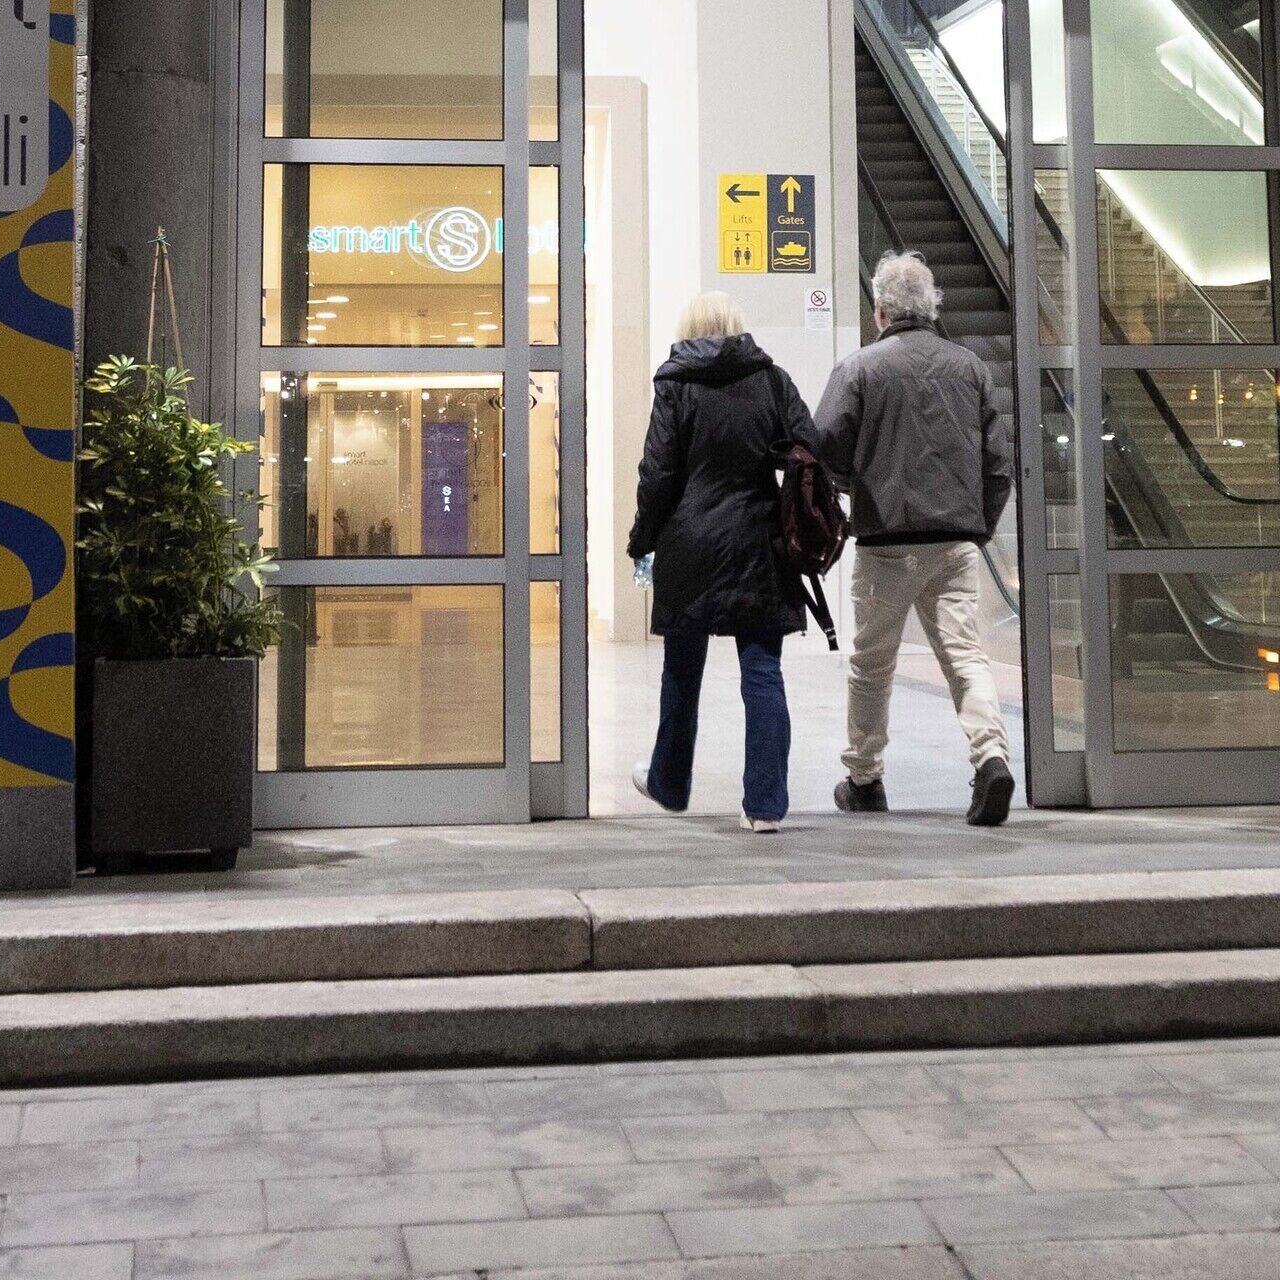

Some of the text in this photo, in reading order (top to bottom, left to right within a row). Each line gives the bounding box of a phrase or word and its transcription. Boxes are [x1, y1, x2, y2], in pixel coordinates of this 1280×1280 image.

[732, 214, 753, 225] Lifts
[776, 214, 805, 225] Gates
[308, 219, 424, 254] smart
